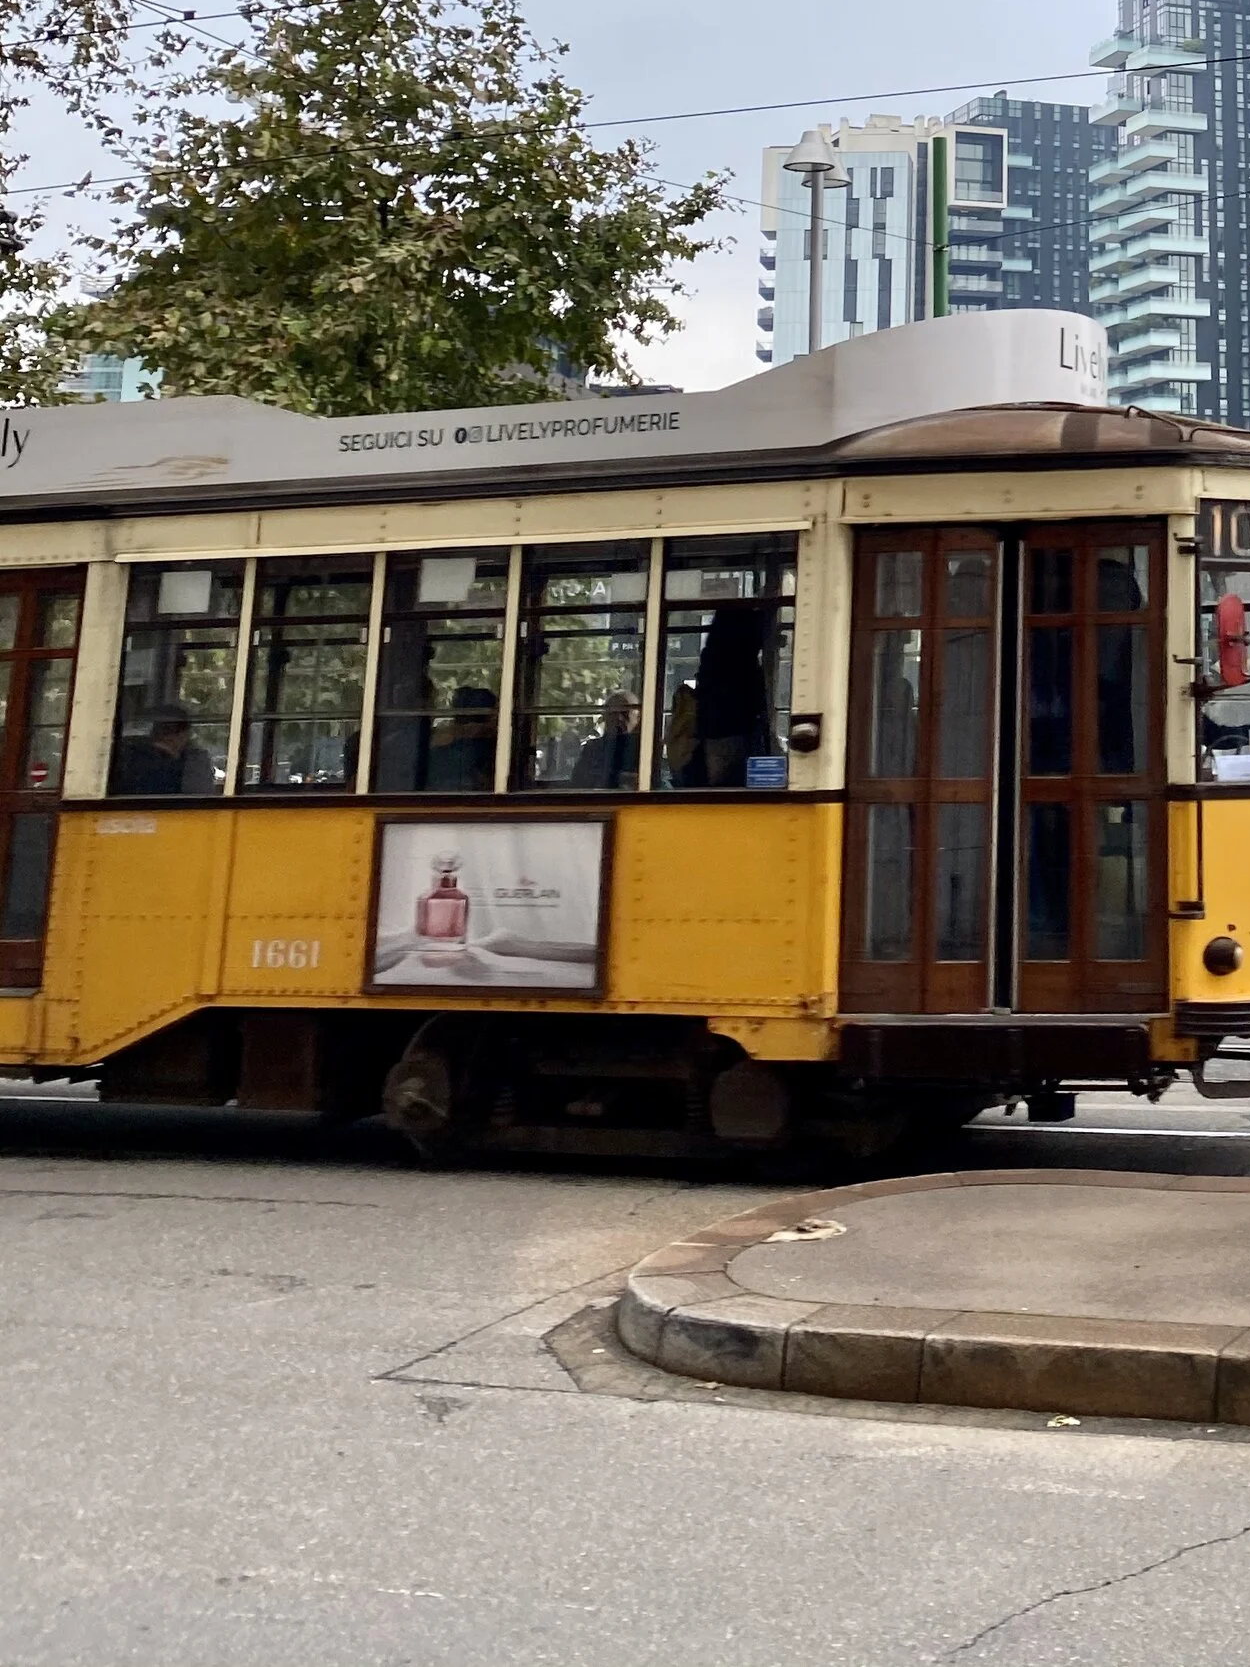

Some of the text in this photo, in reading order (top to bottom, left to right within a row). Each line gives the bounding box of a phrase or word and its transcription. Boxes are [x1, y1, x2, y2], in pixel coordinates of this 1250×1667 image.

[1, 417, 31, 468] ly
[339, 412, 681, 452] SEGUICI SU LIVELYPROFUMERIE
[252, 940, 320, 968] 1661
